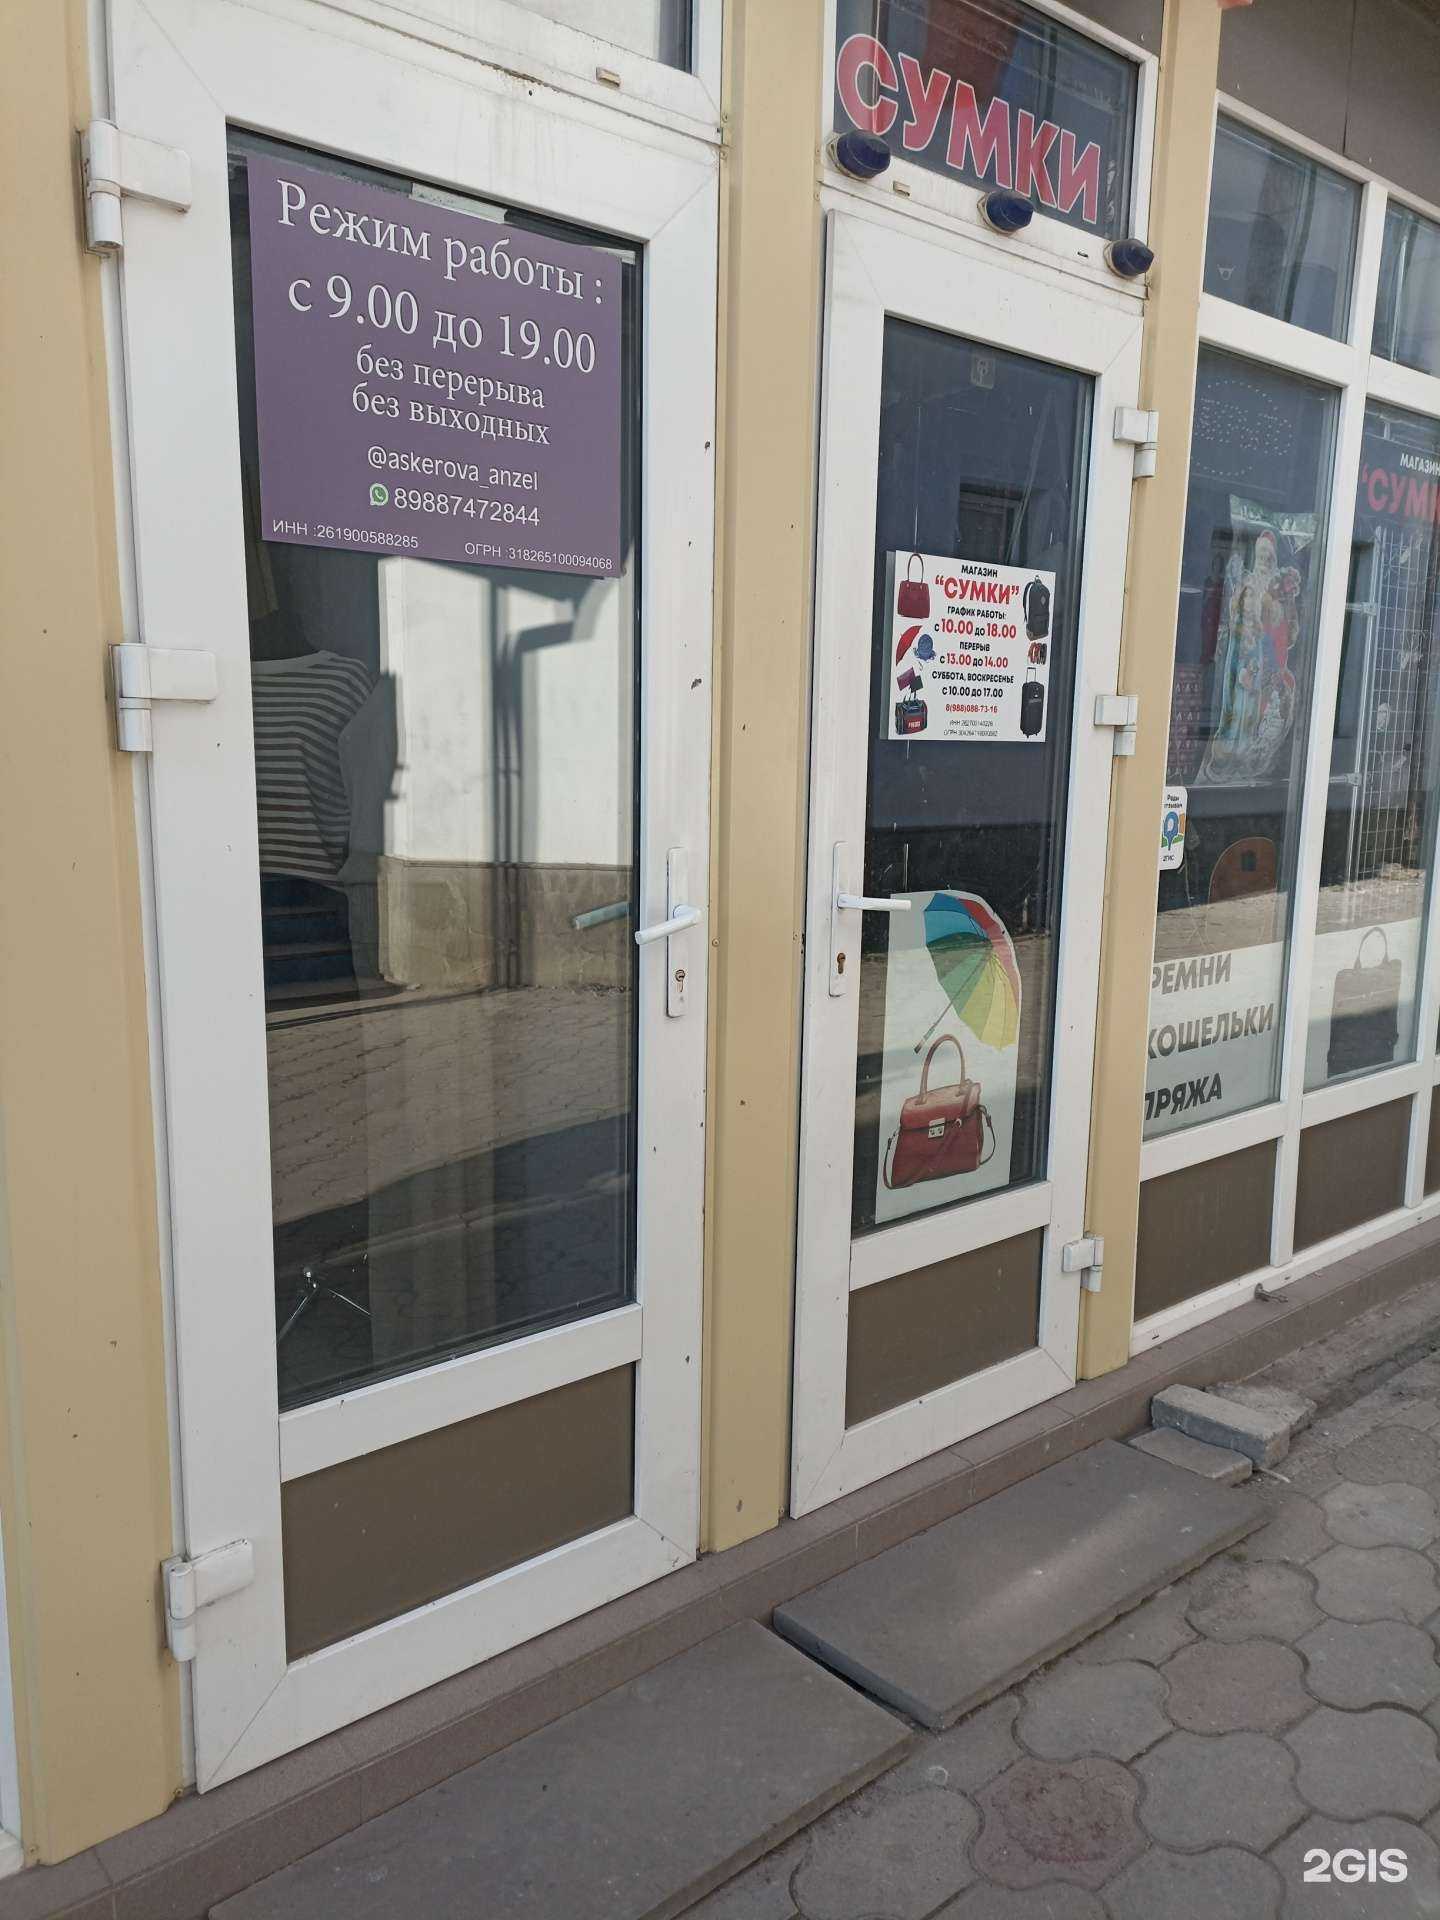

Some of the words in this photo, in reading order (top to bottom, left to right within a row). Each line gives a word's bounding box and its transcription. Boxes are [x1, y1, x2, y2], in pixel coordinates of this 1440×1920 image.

[837, 34, 1101, 224] СУМКИ
[276, 179, 432, 261] Режим
[444, 238, 584, 300] работы
[288, 278, 312, 312] с
[326, 275, 419, 335] 9.00
[432, 310, 483, 353] до
[500, 315, 597, 373] 19.00
[356, 344, 404, 381] без
[413, 362, 545, 408] перерыва
[352, 382, 400, 418] без
[409, 401, 551, 445] выходных
[367, 445, 539, 491] @askerova_anzel
[1400, 453, 1440, 476] МАГАЗИН
[394, 487, 540, 527] 89887472844
[272, 519, 307, 536] ИНН
[464, 542, 501, 558] ОГРН
[961, 564, 998, 578] МАГАЗИН
[947, 605, 976, 617] ГРАФИК
[941, 618, 974, 636] 10.00
[987, 622, 1017, 639] 18.00
[946, 652, 972, 666] 13.00
[984, 655, 1009, 669] 14.00
[959, 641, 991, 652] ПЕРЕРЫВ
[948, 685, 971, 697] 10.00
[983, 687, 1004, 698] 17.00
[967, 672, 1015, 684] ВОСКРЕСЕНЬЕ
[1151, 953, 1232, 995] РЕМНИ
[1148, 1003, 1274, 1060] КОШЕЛЬКИ
[1145, 1072, 1223, 1121] ПРЯЖА
